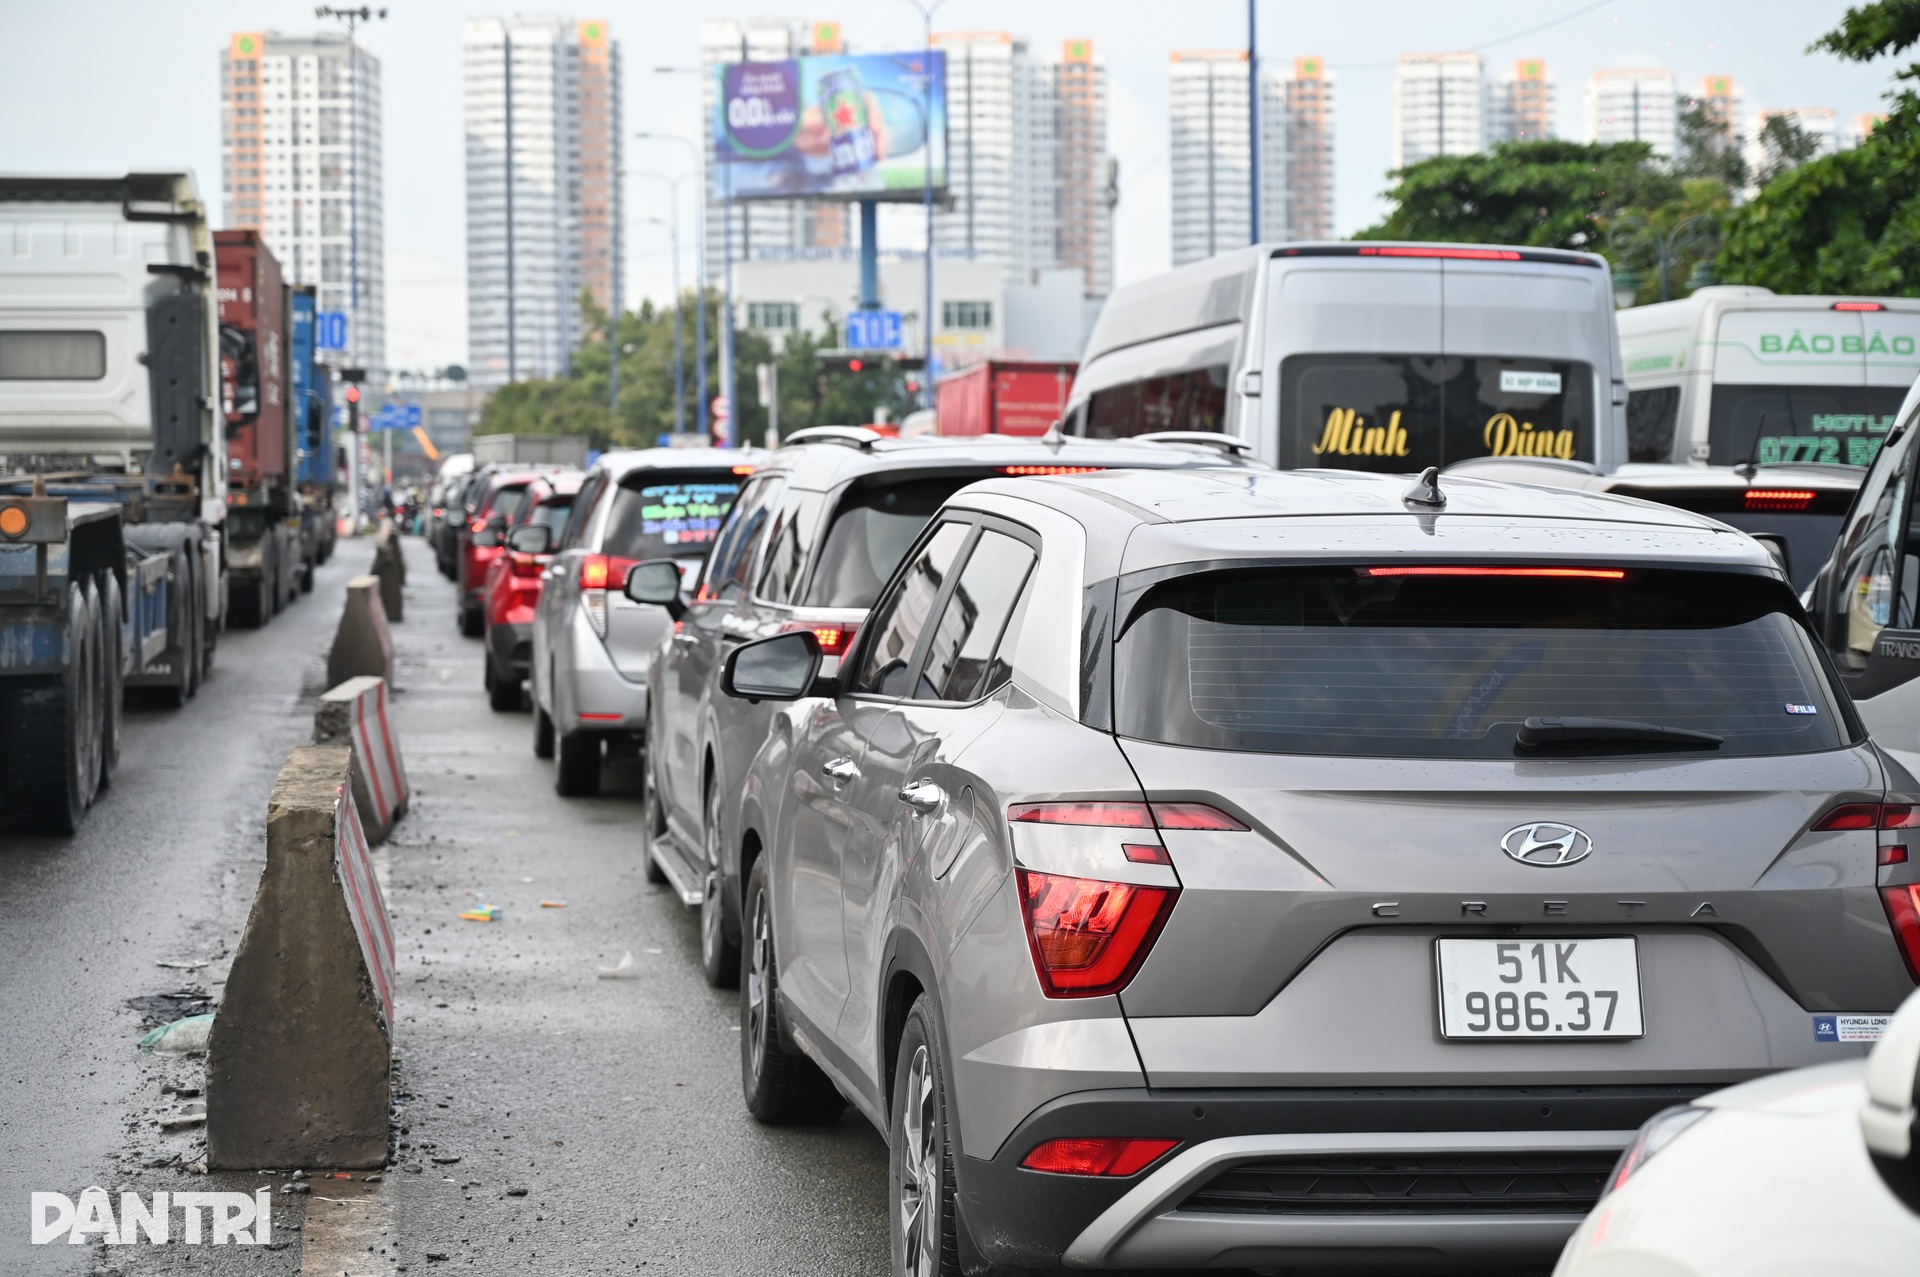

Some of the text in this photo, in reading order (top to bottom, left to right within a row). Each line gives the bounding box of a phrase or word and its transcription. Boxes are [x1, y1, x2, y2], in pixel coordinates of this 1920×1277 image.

[1760, 329, 1915, 355] BẢO BẢO
[1311, 406, 1410, 456] Minh
[1880, 641, 1920, 659] TRANS
[1372, 900, 1721, 918] CRETA
[1496, 943, 1582, 984] 51K
[1465, 990, 1619, 1032] 986.37
